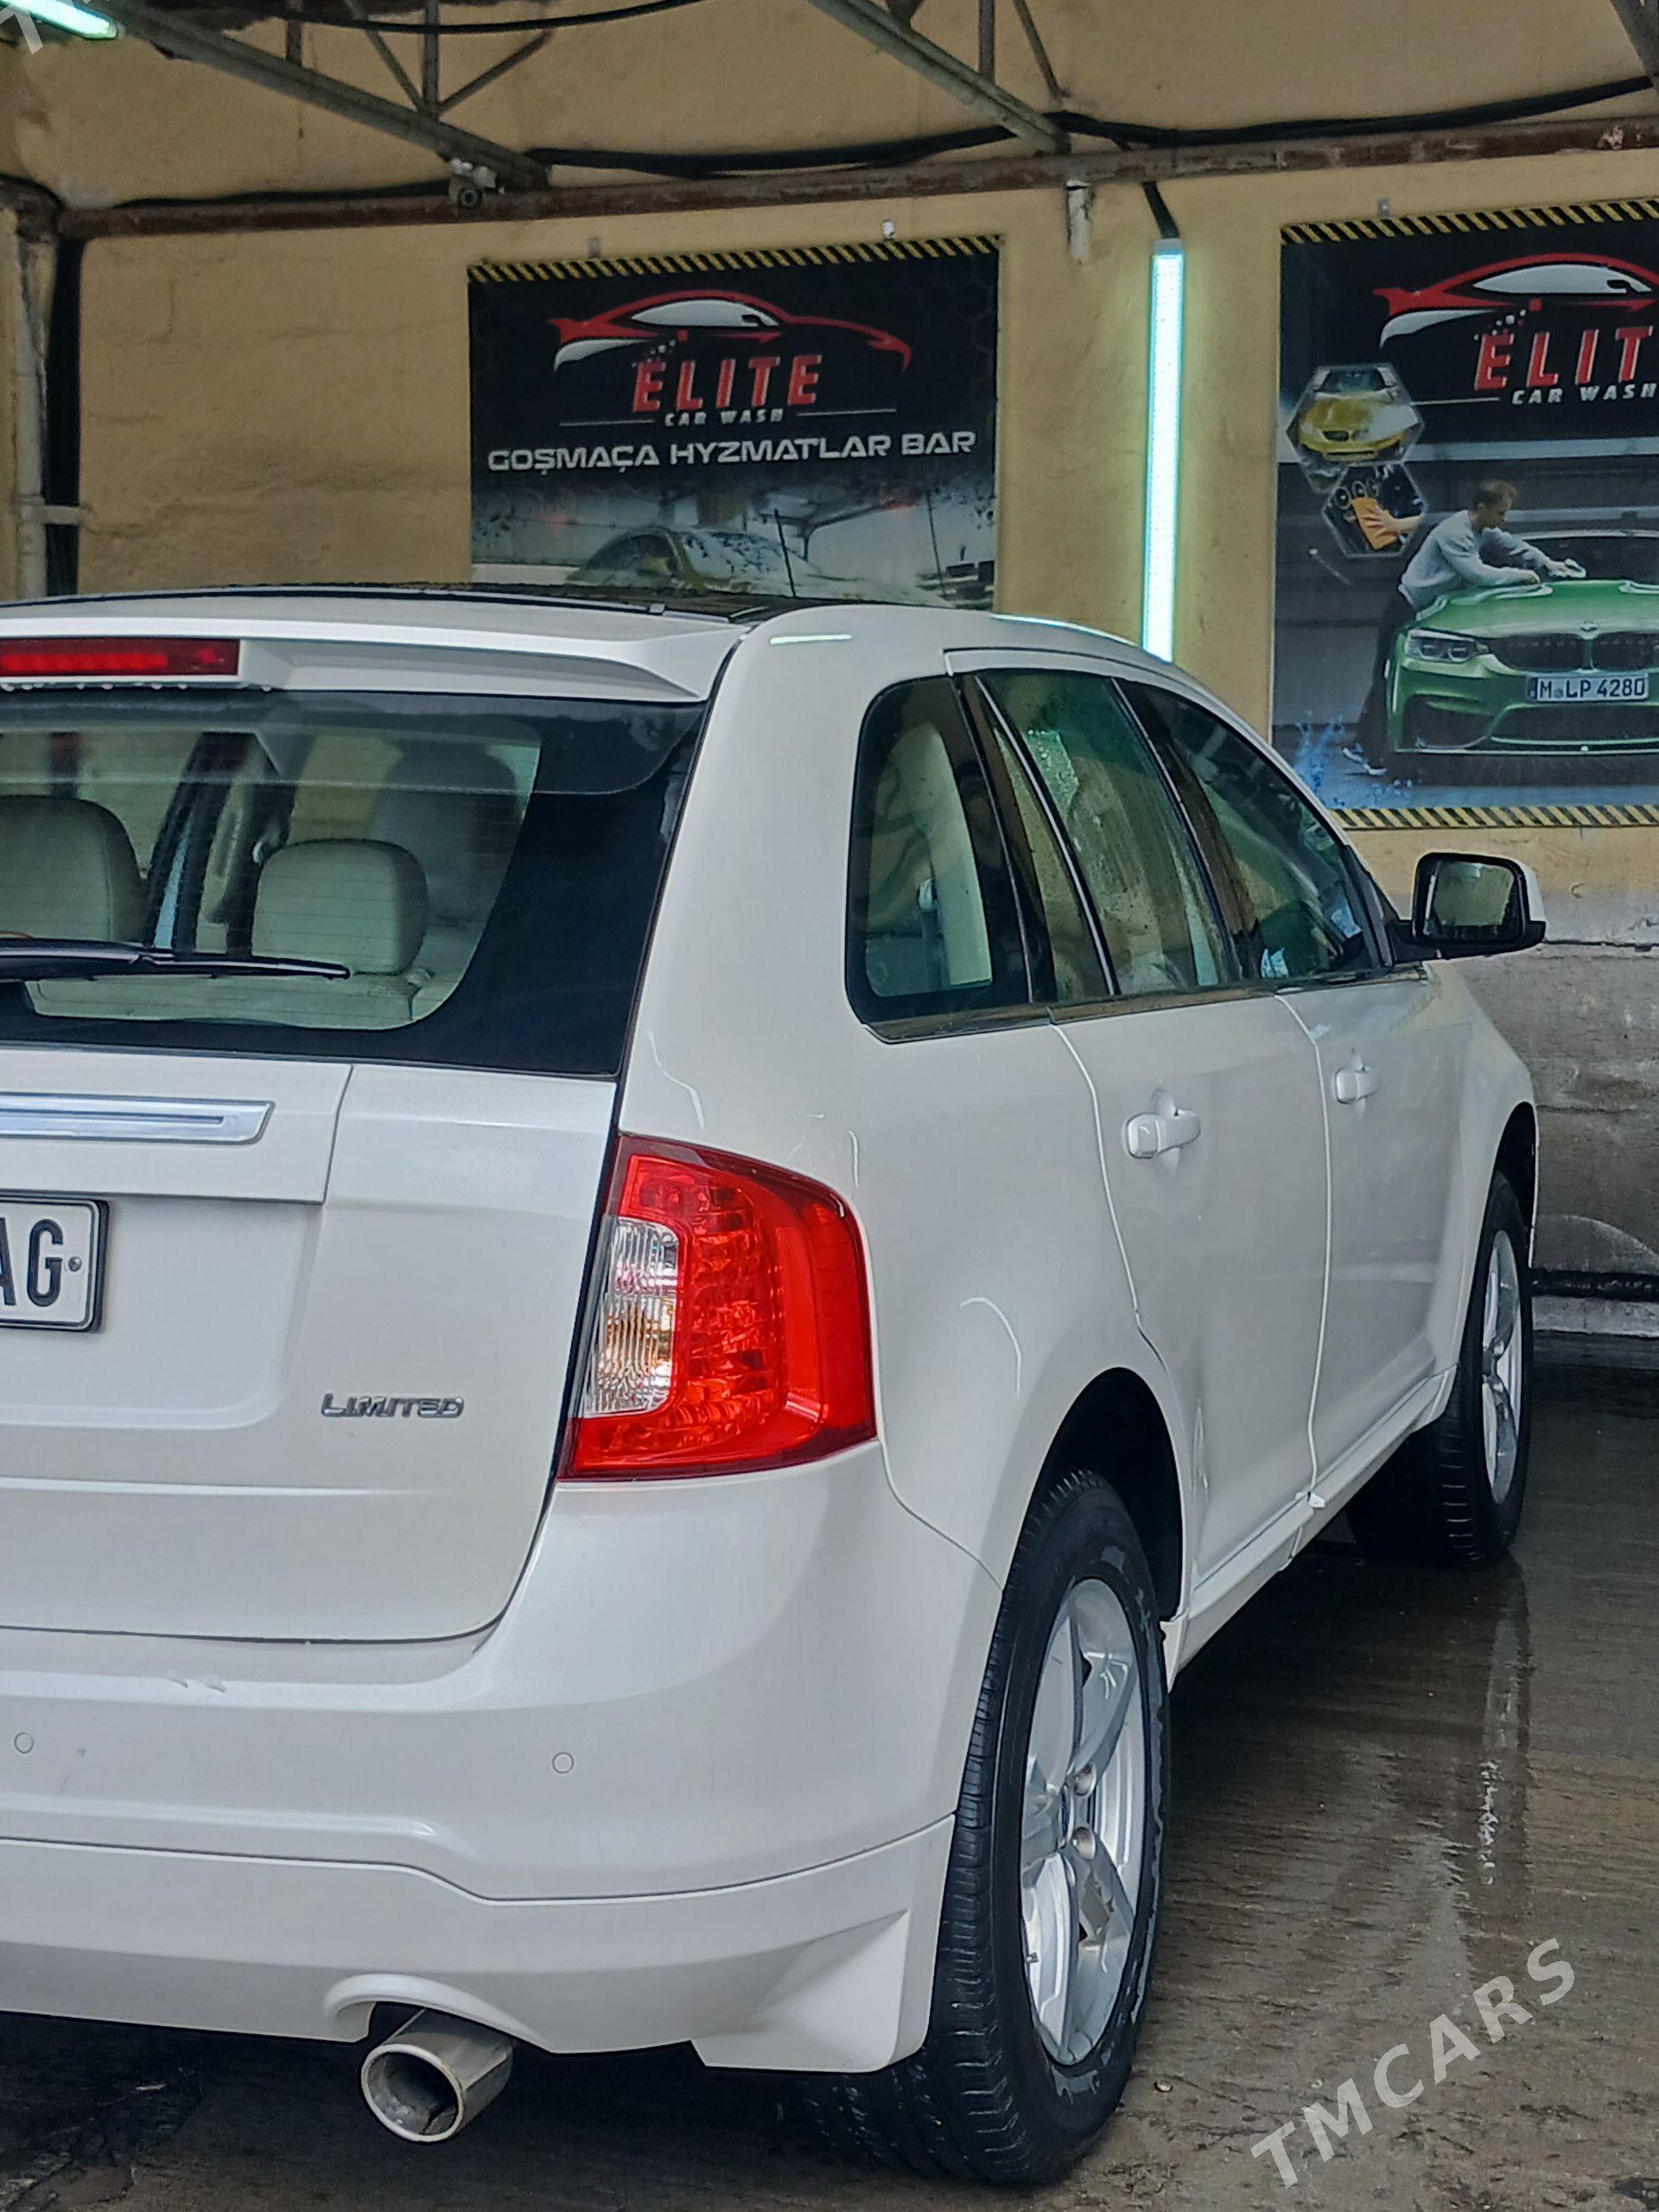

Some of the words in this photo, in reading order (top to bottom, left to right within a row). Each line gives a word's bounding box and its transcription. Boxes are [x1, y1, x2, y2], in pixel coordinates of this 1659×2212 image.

[632, 354, 822, 412] ELITE
[1511, 388, 1563, 404] CAR
[1580, 383, 1657, 401] WASH
[664, 411, 707, 427] CAR
[721, 408, 784, 424] WASH
[487, 444, 660, 475] GOŞMAÇA
[670, 435, 892, 465] HYZMATLAR
[901, 430, 976, 455] BAR
[1540, 680, 1552, 698] M
[1566, 679, 1591, 698] LP
[1597, 677, 1645, 697] 4280
[321, 1393, 465, 1418] LIMITED
